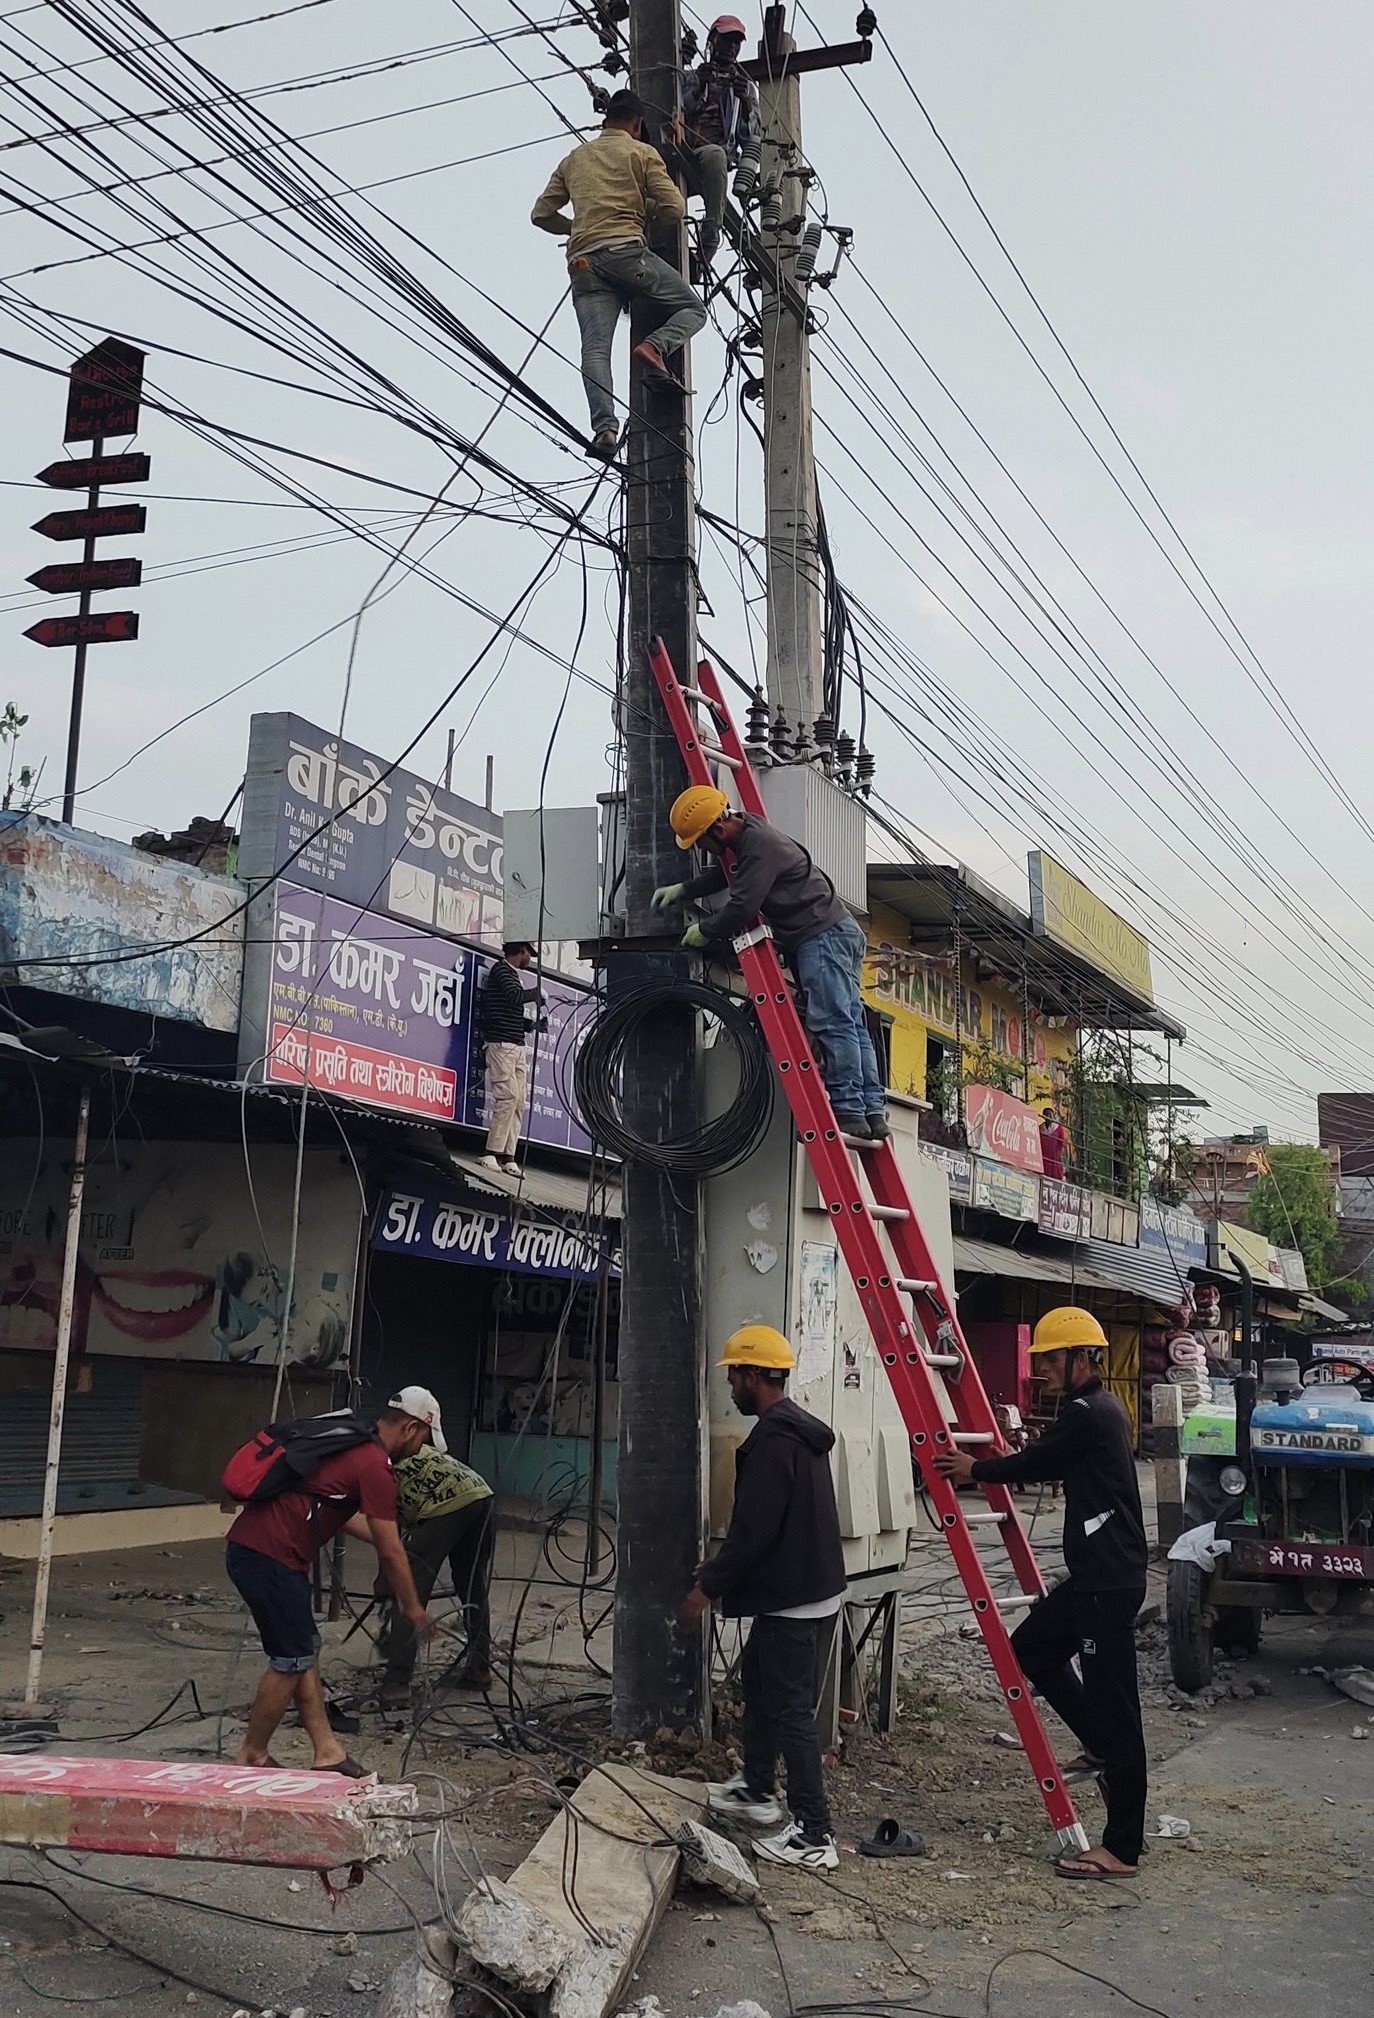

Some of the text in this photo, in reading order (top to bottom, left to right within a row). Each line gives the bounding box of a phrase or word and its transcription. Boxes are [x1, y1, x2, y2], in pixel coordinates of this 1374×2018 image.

[105, 409, 135, 429] Grill
[286, 740, 392, 827] बाँके
[284, 801, 298, 821] Dr.
[299, 808, 317, 829] Anil
[331, 821, 355, 845] Gupta
[289, 825, 302, 839] BDS
[1063, 879, 1104, 943] Shandar
[276, 910, 466, 1028] डा. कमर जहाँ
[272, 1003, 293, 1023] NMC
[314, 1015, 334, 1034] 7360
[315, 1045, 348, 1087] प्रसूति
[349, 1057, 374, 1088] तथा
[80, 1212, 116, 1240] FTER
[383, 1192, 423, 1245] डा.
[431, 1201, 507, 1262] कमर
[1261, 1432, 1362, 1451] STANDARD
[1321, 1555, 1366, 1578] ३३२३
